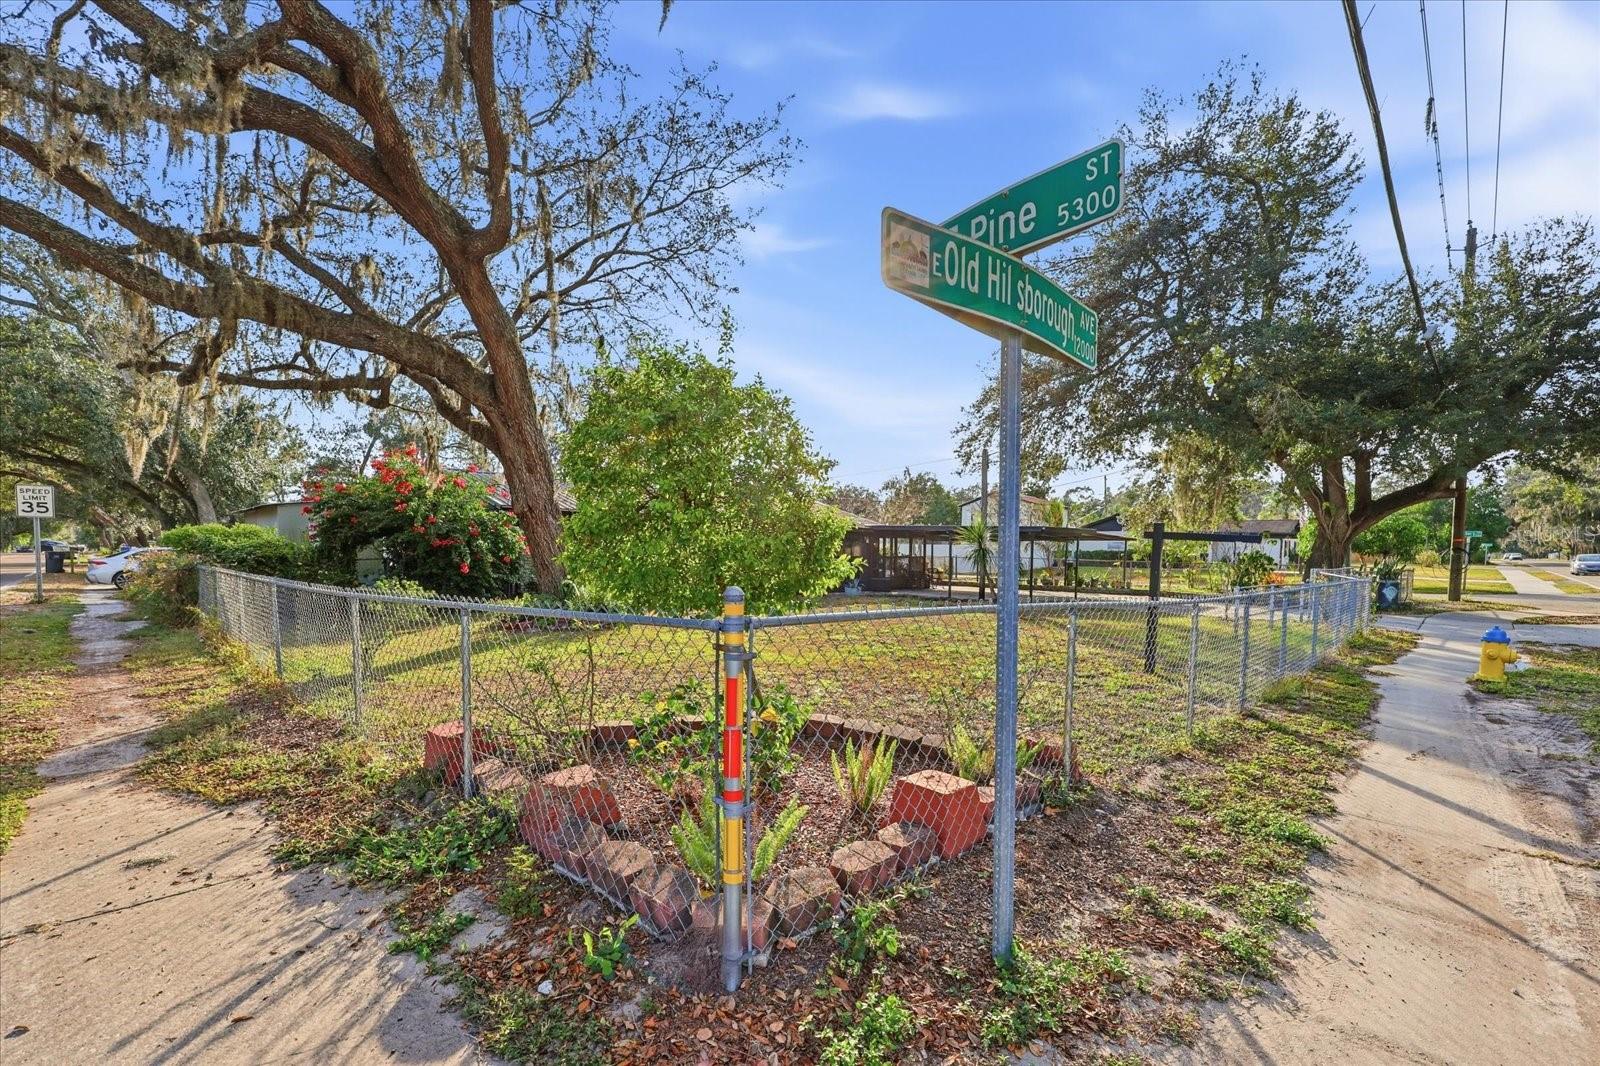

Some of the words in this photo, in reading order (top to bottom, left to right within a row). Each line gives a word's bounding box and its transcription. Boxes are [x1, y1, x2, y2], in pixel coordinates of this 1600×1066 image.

[1085, 150, 1112, 181] ST
[1057, 184, 1116, 226] 5300
[970, 201, 1037, 247] Pine
[933, 253, 943, 277] E
[944, 240, 980, 294] Old
[987, 255, 1075, 347] Hilsborough
[1080, 311, 1095, 336] AVE
[1073, 335, 1095, 362] 12000
[22, 502, 50, 513] 35
